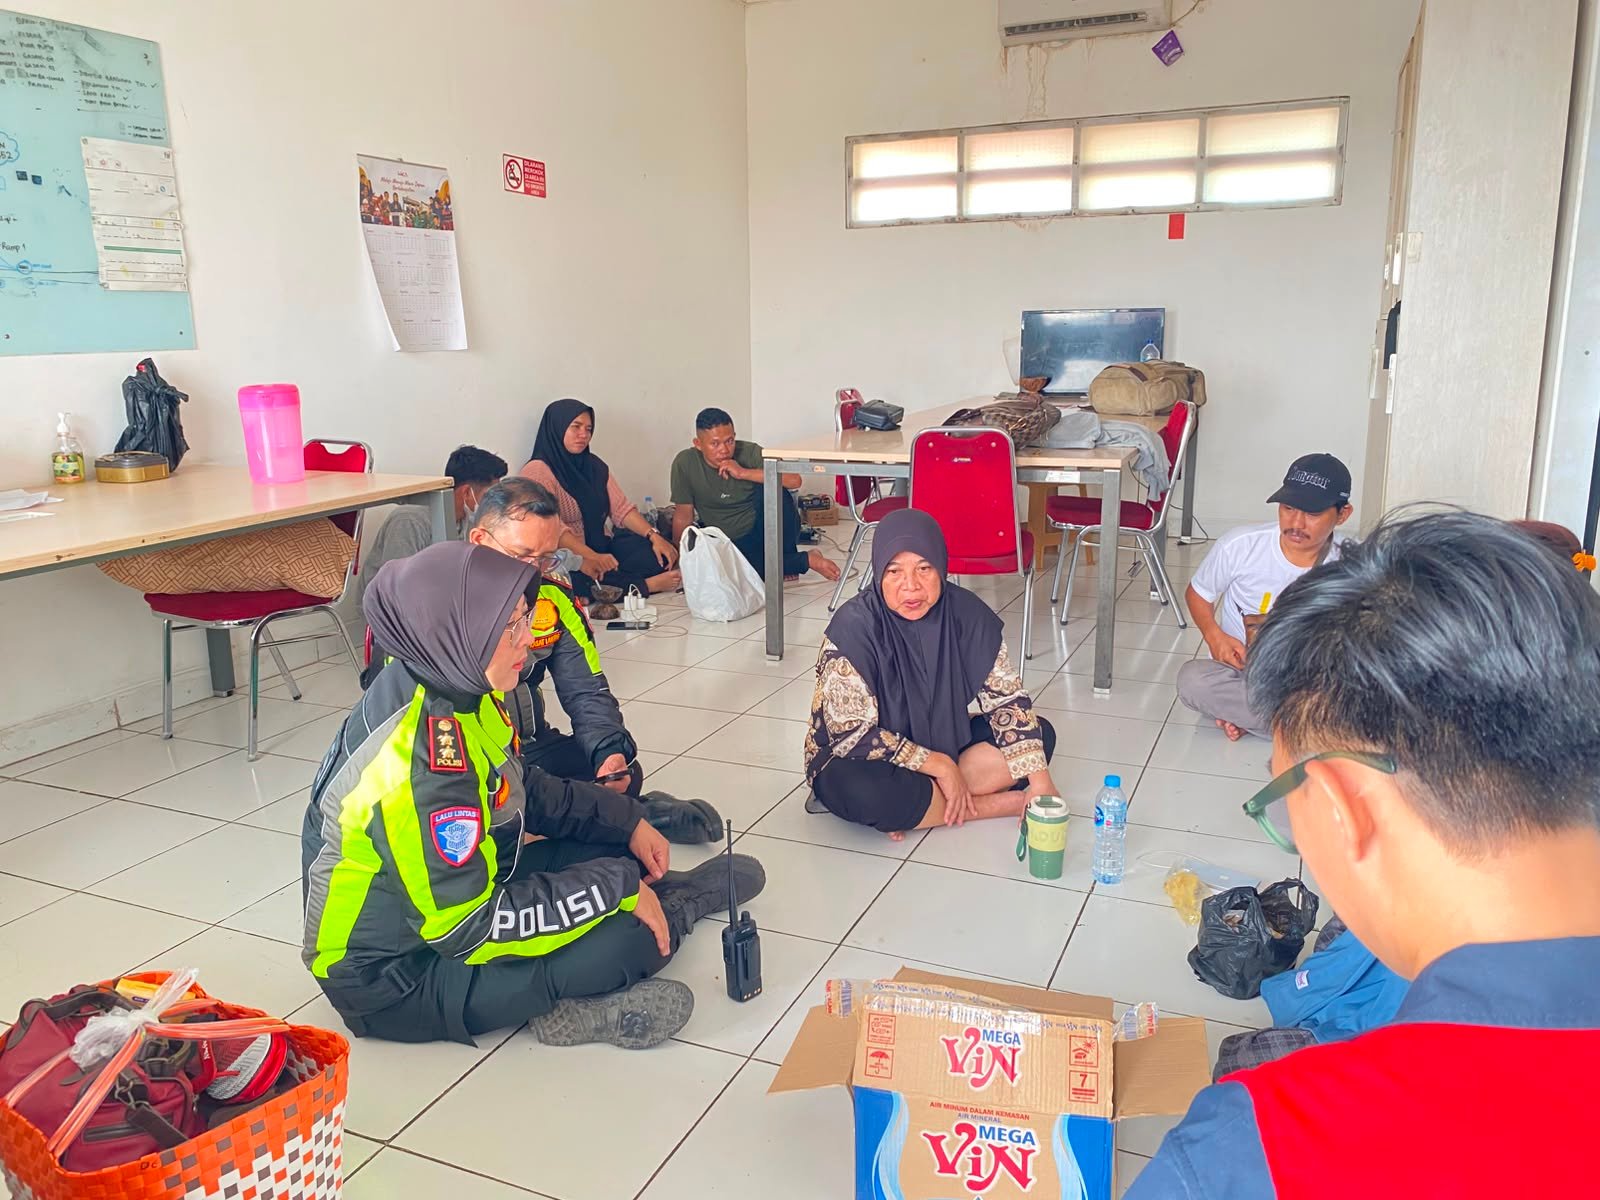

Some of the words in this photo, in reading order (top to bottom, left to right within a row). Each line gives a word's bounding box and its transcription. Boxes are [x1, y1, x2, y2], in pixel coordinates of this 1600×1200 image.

[437, 758, 463, 767] POLISI
[435, 813, 453, 822] LALU
[454, 811, 476, 820] LINTAS
[491, 885, 606, 939] POLISI
[982, 1029, 1021, 1046] MEGA
[1079, 1073, 1088, 1088] 7
[929, 1101, 942, 1109] AIR
[943, 1103, 968, 1113] MINUM
[969, 1107, 994, 1116] DALAM
[995, 1110, 1030, 1120] KEMASAN
[970, 1114, 1002, 1123] MINERAL
[979, 1125, 1036, 1146] MEGA
